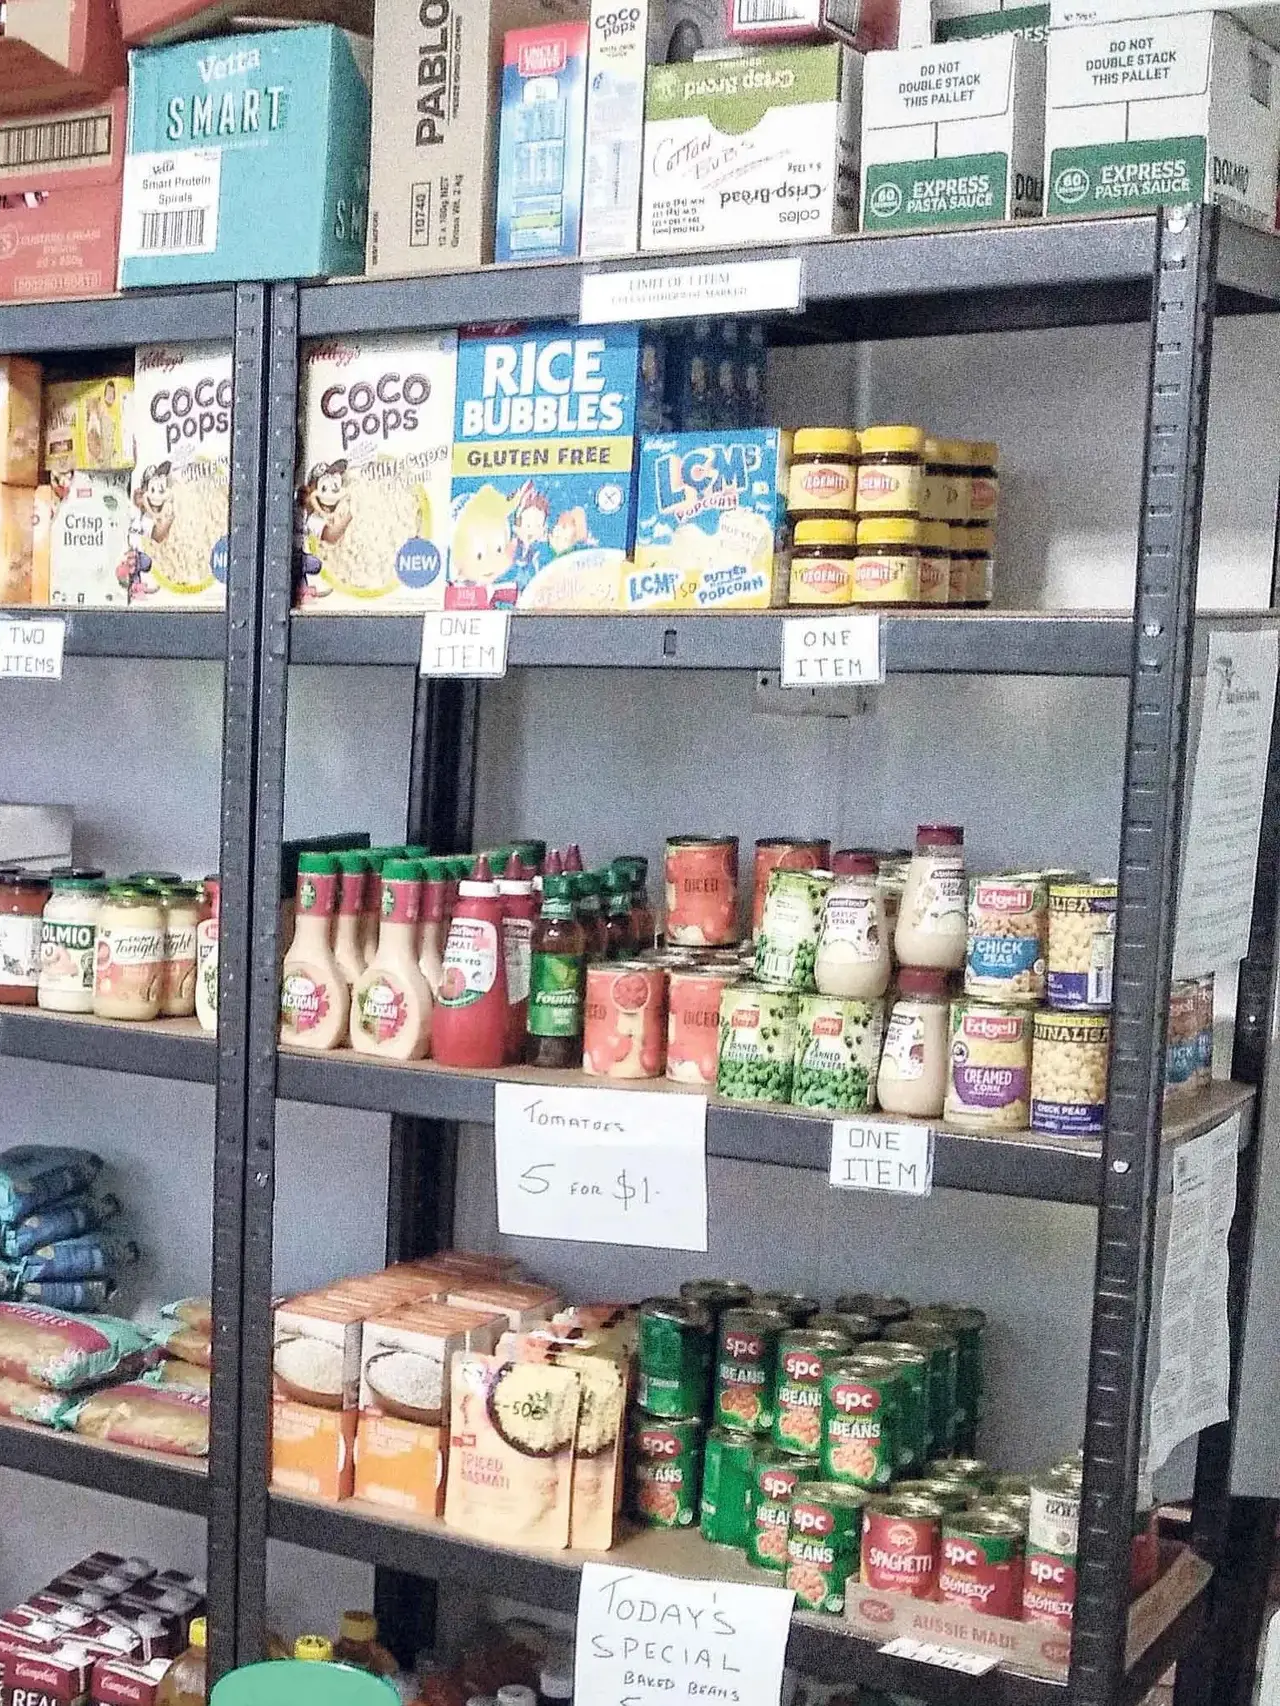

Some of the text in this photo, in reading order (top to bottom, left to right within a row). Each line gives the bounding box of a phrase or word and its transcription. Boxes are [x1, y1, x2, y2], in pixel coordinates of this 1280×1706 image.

[1108, 36, 1155, 54] DO NOT
[920, 61, 960, 78] DO NOT
[1085, 51, 1177, 72] DOUBLE STACK
[415, 0, 450, 147] PABLO
[1091, 67, 1171, 87] THIS PALLET
[898, 74, 981, 95] DOUBLE STACK
[903, 90, 975, 109] THIS PALLET
[167, 86, 284, 140] SMART
[1100, 160, 1188, 184] EXPRESS
[142, 179, 171, 190] Smart
[912, 174, 990, 198] EXPRESS
[1095, 178, 1192, 199] PASTA SAUCE
[158, 192, 193, 206] Spirals
[906, 193, 993, 214] PASTA SAUCE
[778, 208, 820, 225] coles
[482, 338, 607, 398] RICE
[461, 393, 626, 437] BUBBLES
[166, 411, 229, 454] pops
[341, 407, 419, 452] pops
[466, 445, 612, 468] GLUTEN FREE
[675, 494, 738, 522] POPCORN
[64, 512, 104, 535] Crisp
[63, 529, 105, 548] Bread
[399, 554, 438, 571] NEW
[697, 576, 764, 604] POPCORN
[8, 627, 46, 646] TWO
[438, 617, 482, 637] ONE
[802, 628, 853, 648] ONE
[1, 655, 56, 674] ITEMS
[432, 644, 497, 669] ITEM
[794, 657, 863, 678] ITEM
[683, 877, 719, 894] DICED
[976, 888, 1027, 910] Edgell
[976, 941, 1023, 956] CHICK
[982, 953, 1013, 965] PEAS
[683, 1009, 720, 1026] DICED
[963, 1016, 1019, 1039] Edgell
[963, 1068, 1013, 1088] CREAMED
[972, 1083, 1002, 1094] CORN
[1061, 1104, 1087, 1117] PEAS
[847, 1127, 901, 1151] ONE
[517, 1162, 603, 1198] 5 FOR
[842, 1157, 918, 1187] ITEM
[725, 1336, 759, 1358] spc
[720, 1364, 766, 1384] BEANS
[786, 1357, 821, 1379] spc
[779, 1387, 822, 1407] BEAN
[835, 1388, 873, 1412] spc
[829, 1420, 881, 1439] BEANS
[641, 1436, 676, 1456] spc
[792, 1509, 827, 1533] spc
[788, 1543, 835, 1564] BEANS
[869, 1547, 933, 1574] SPAGHETTI
[944, 1542, 979, 1566] spc
[1030, 1559, 1067, 1584] spc
[598, 1574, 737, 1637] TODAY'S
[911, 1613, 970, 1639] AUSSIE
[591, 1633, 741, 1673] SPECIAL
[623, 1670, 741, 1703] BAKED BEANS
